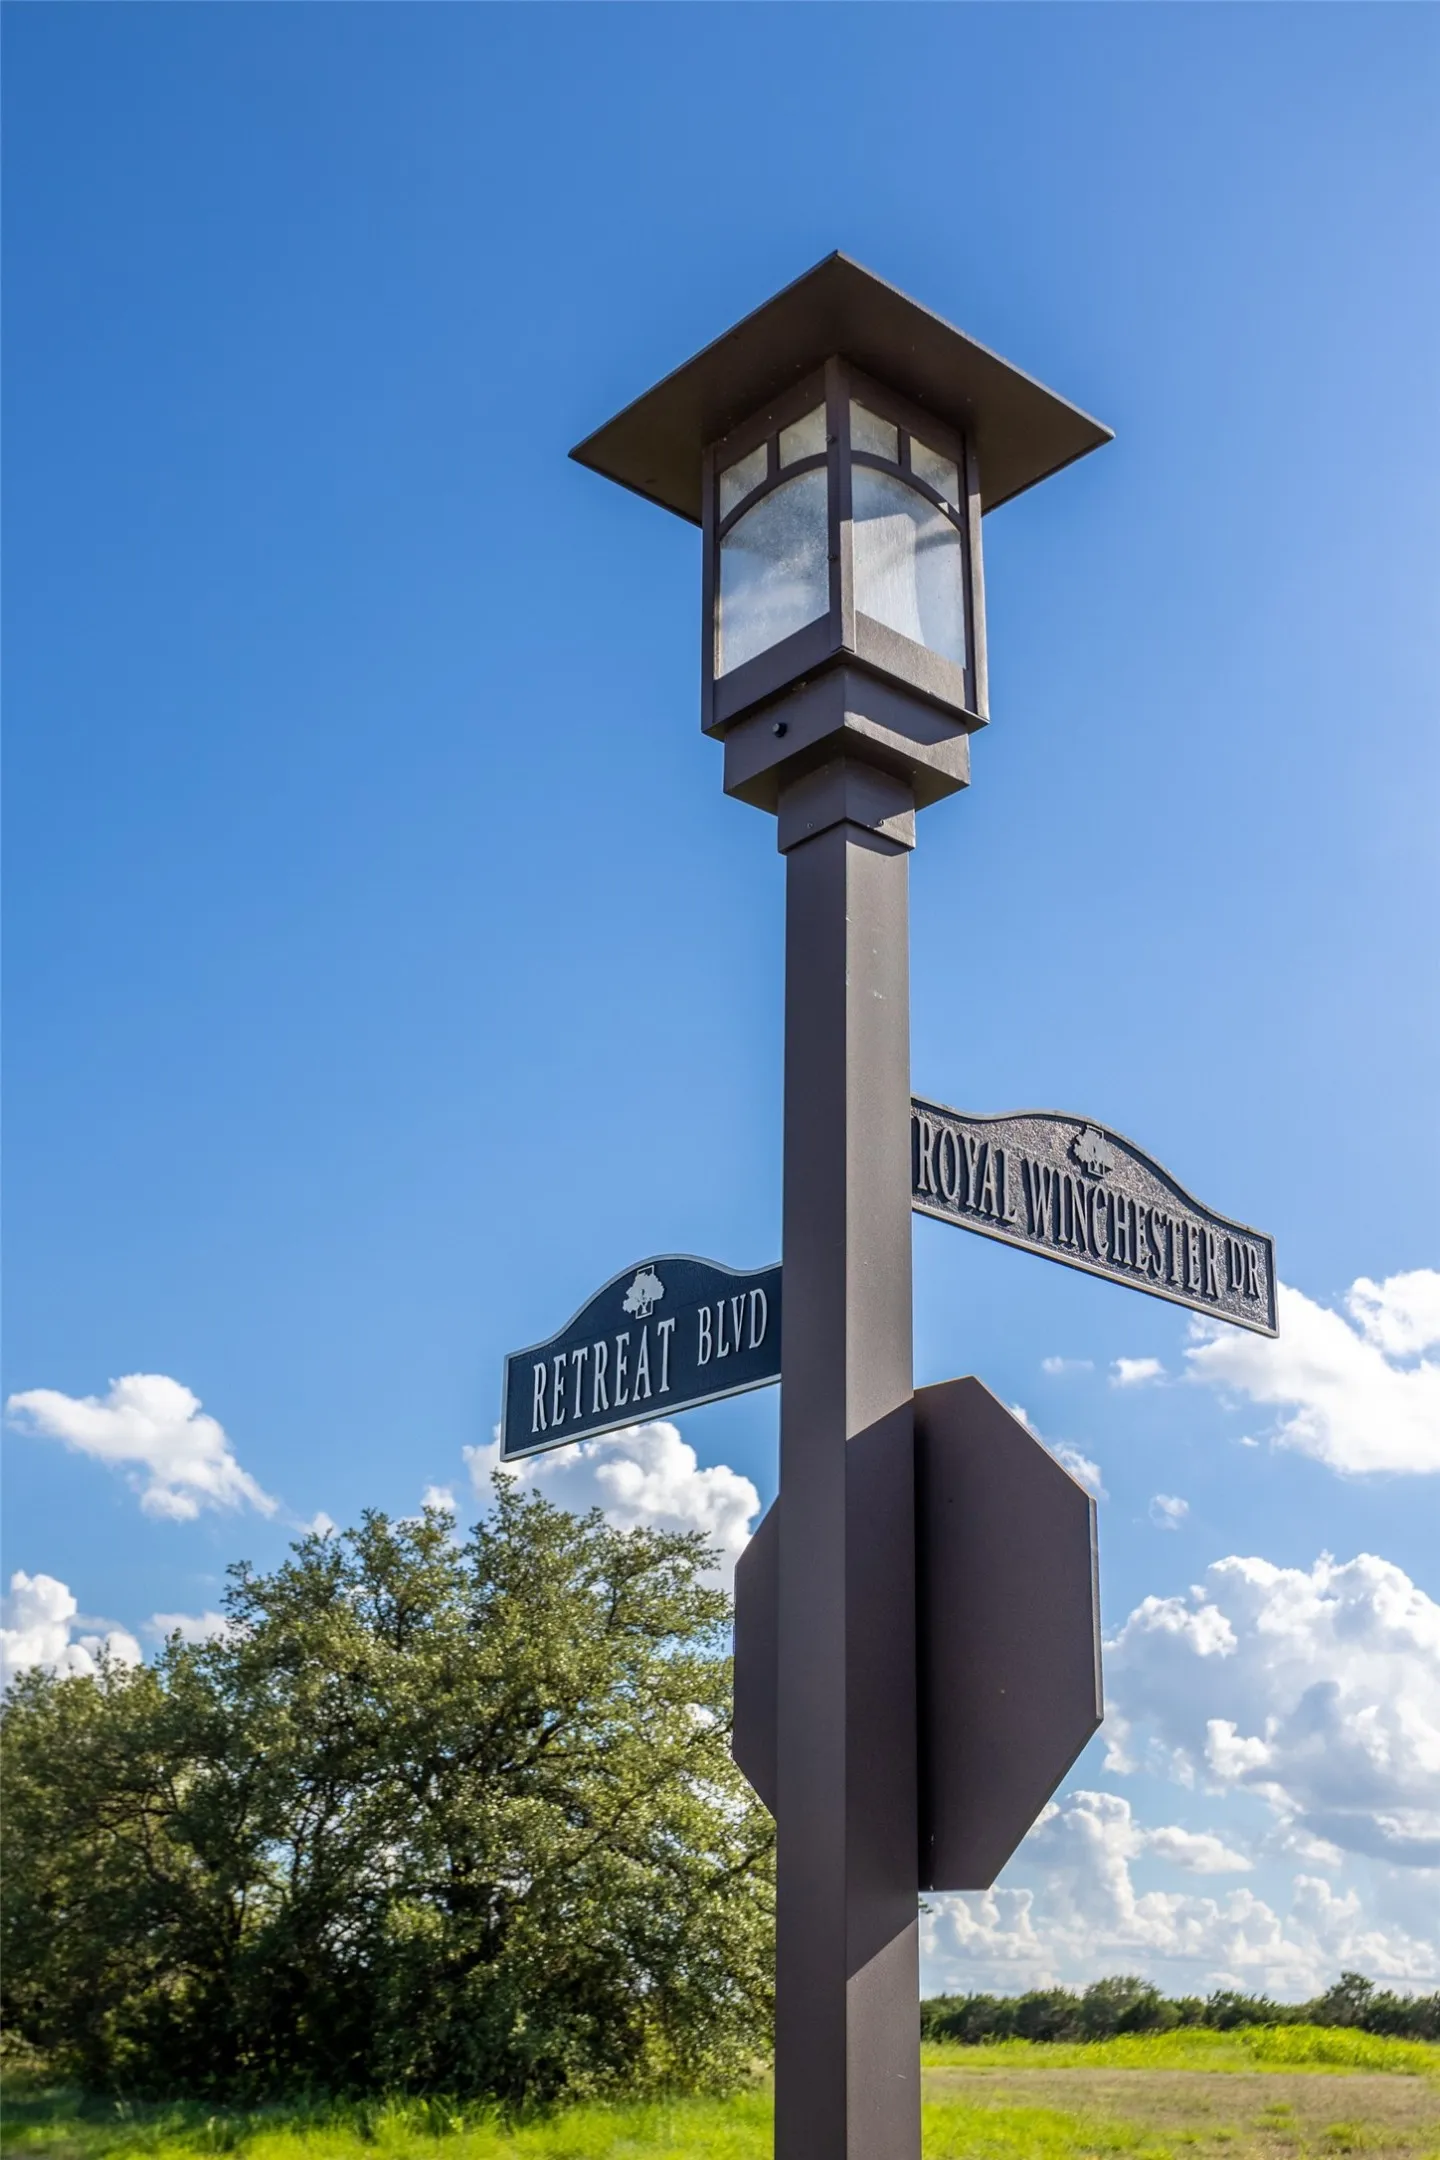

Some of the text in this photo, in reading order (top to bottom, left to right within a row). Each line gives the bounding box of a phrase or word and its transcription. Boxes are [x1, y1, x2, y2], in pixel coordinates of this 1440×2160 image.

[916, 1115, 1262, 1299] ROYAL WINCHESTER DR
[531, 1288, 768, 1433] RETREAT BLVD
